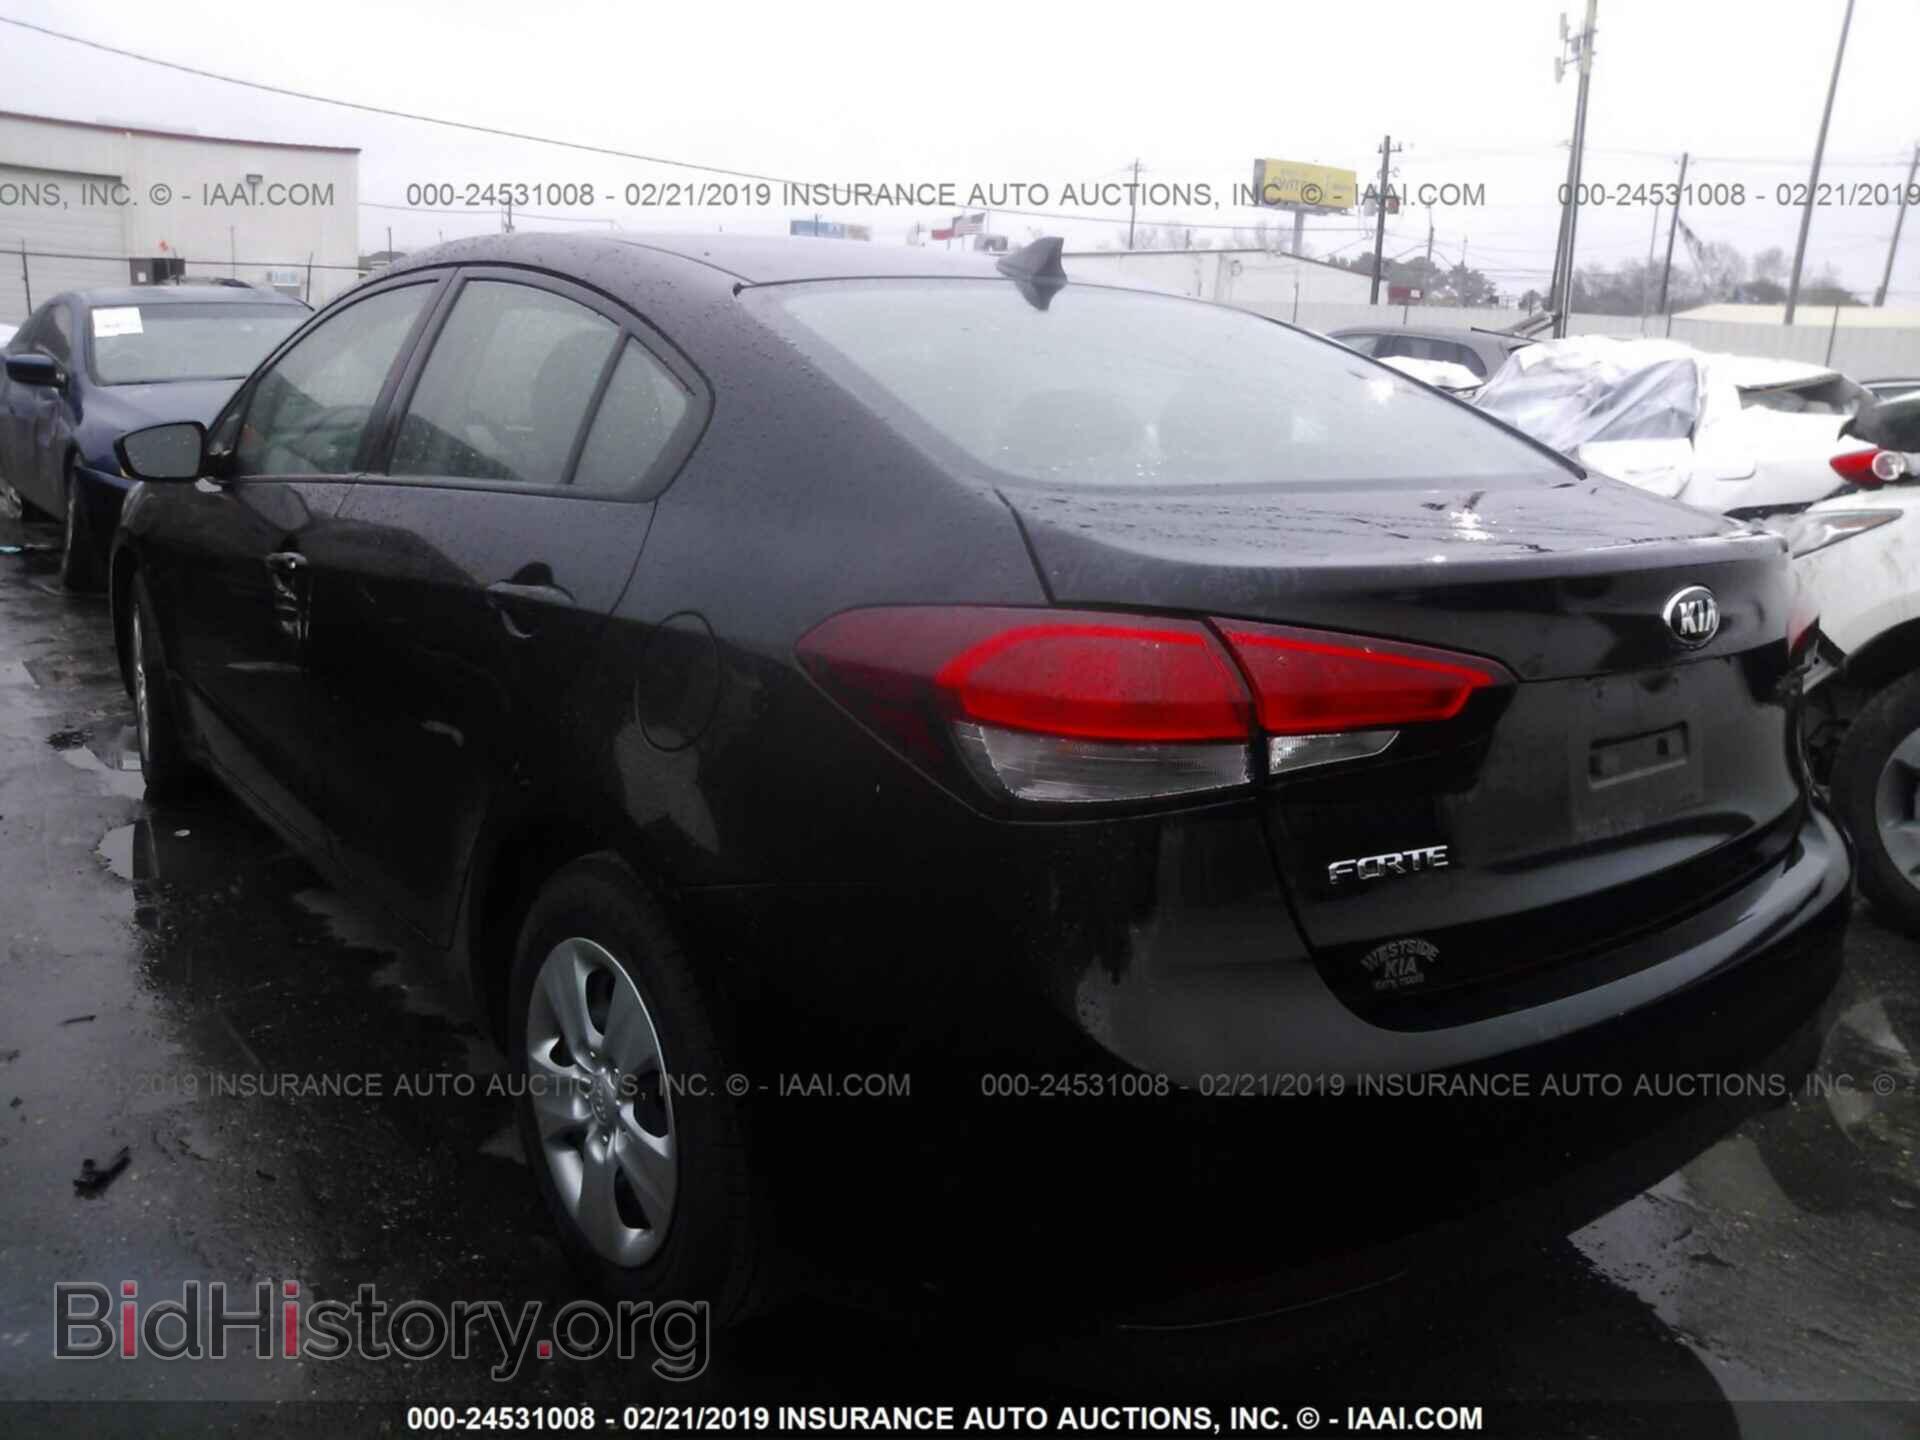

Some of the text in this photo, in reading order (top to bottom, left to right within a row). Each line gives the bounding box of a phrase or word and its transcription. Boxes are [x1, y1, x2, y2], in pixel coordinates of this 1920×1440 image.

[1678, 598, 1717, 635] KIA
[1328, 845, 1449, 884] FORTE
[1360, 938, 1441, 971] WESTSIDE
[1384, 955, 1418, 978] KIA
